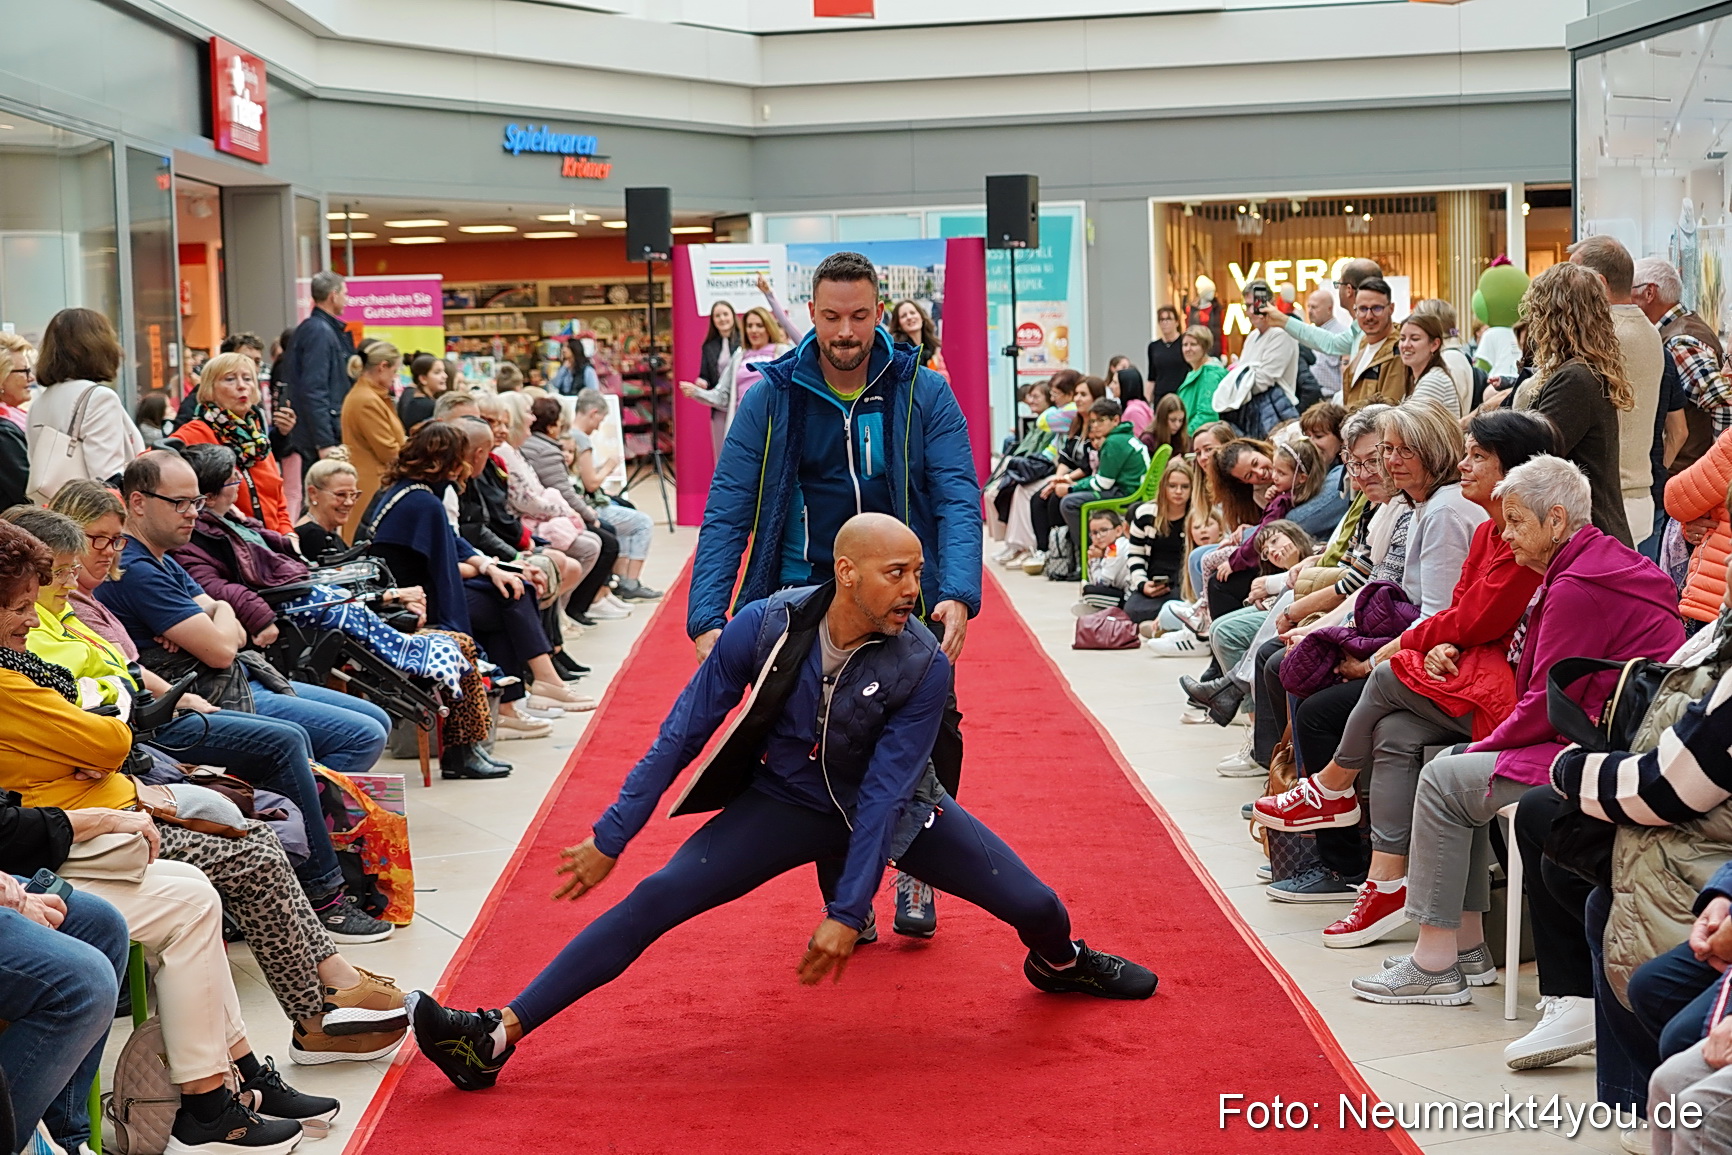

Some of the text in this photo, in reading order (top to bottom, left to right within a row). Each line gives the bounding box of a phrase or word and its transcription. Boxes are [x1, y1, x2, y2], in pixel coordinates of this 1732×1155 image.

[503, 123, 598, 156] Spielwaren
[562, 156, 612, 179] Krömer
[706, 277, 775, 288] NeuerMat
[413, 292, 432, 305] Sie
[363, 305, 433, 319] Gutscheine!
